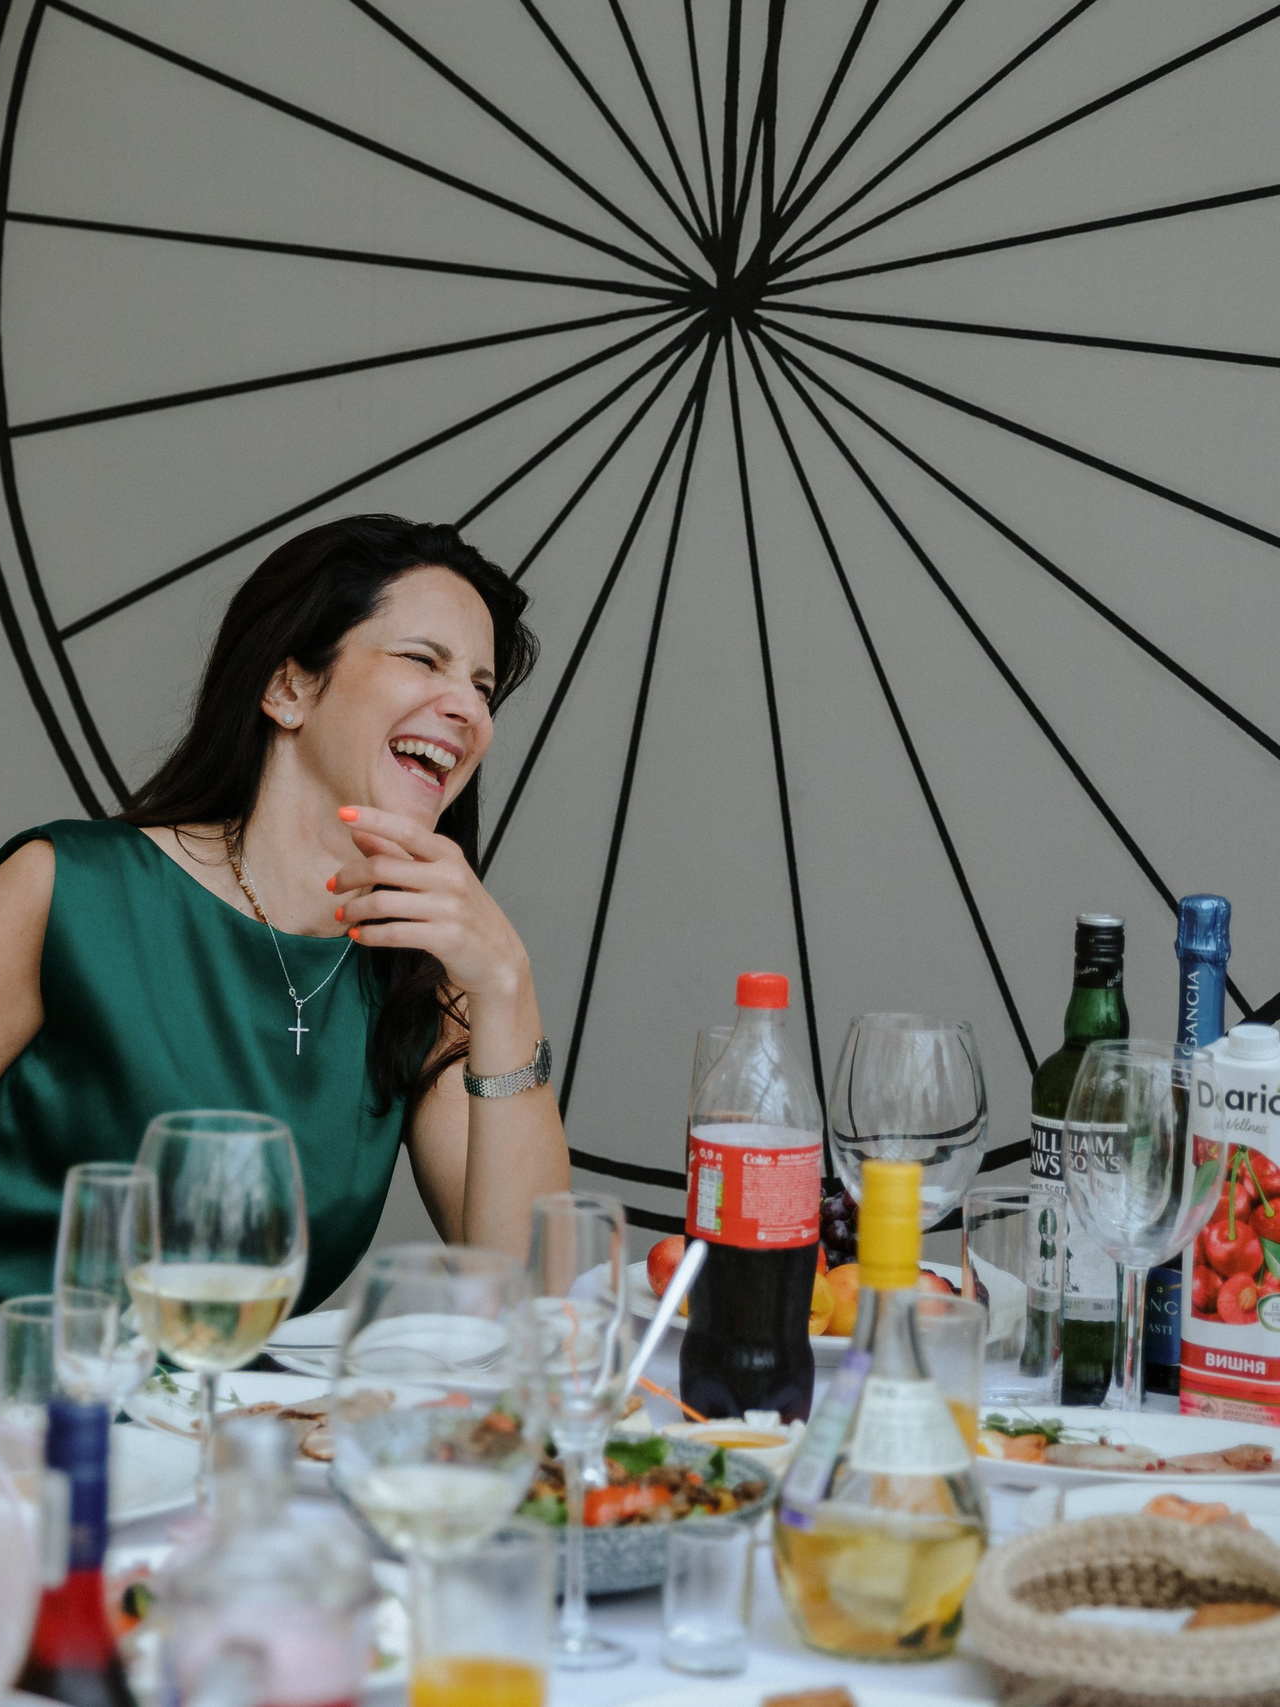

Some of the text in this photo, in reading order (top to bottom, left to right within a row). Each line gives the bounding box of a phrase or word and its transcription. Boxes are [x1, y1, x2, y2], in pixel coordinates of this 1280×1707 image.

[1184, 970, 1200, 1056] GANCIA
[699, 1147, 714, 1160] 0,9
[1031, 1150, 1121, 1175] AWSON'S
[1148, 1323, 1172, 1335] ASTI
[1205, 1352, 1266, 1375] ВИШНЯ
